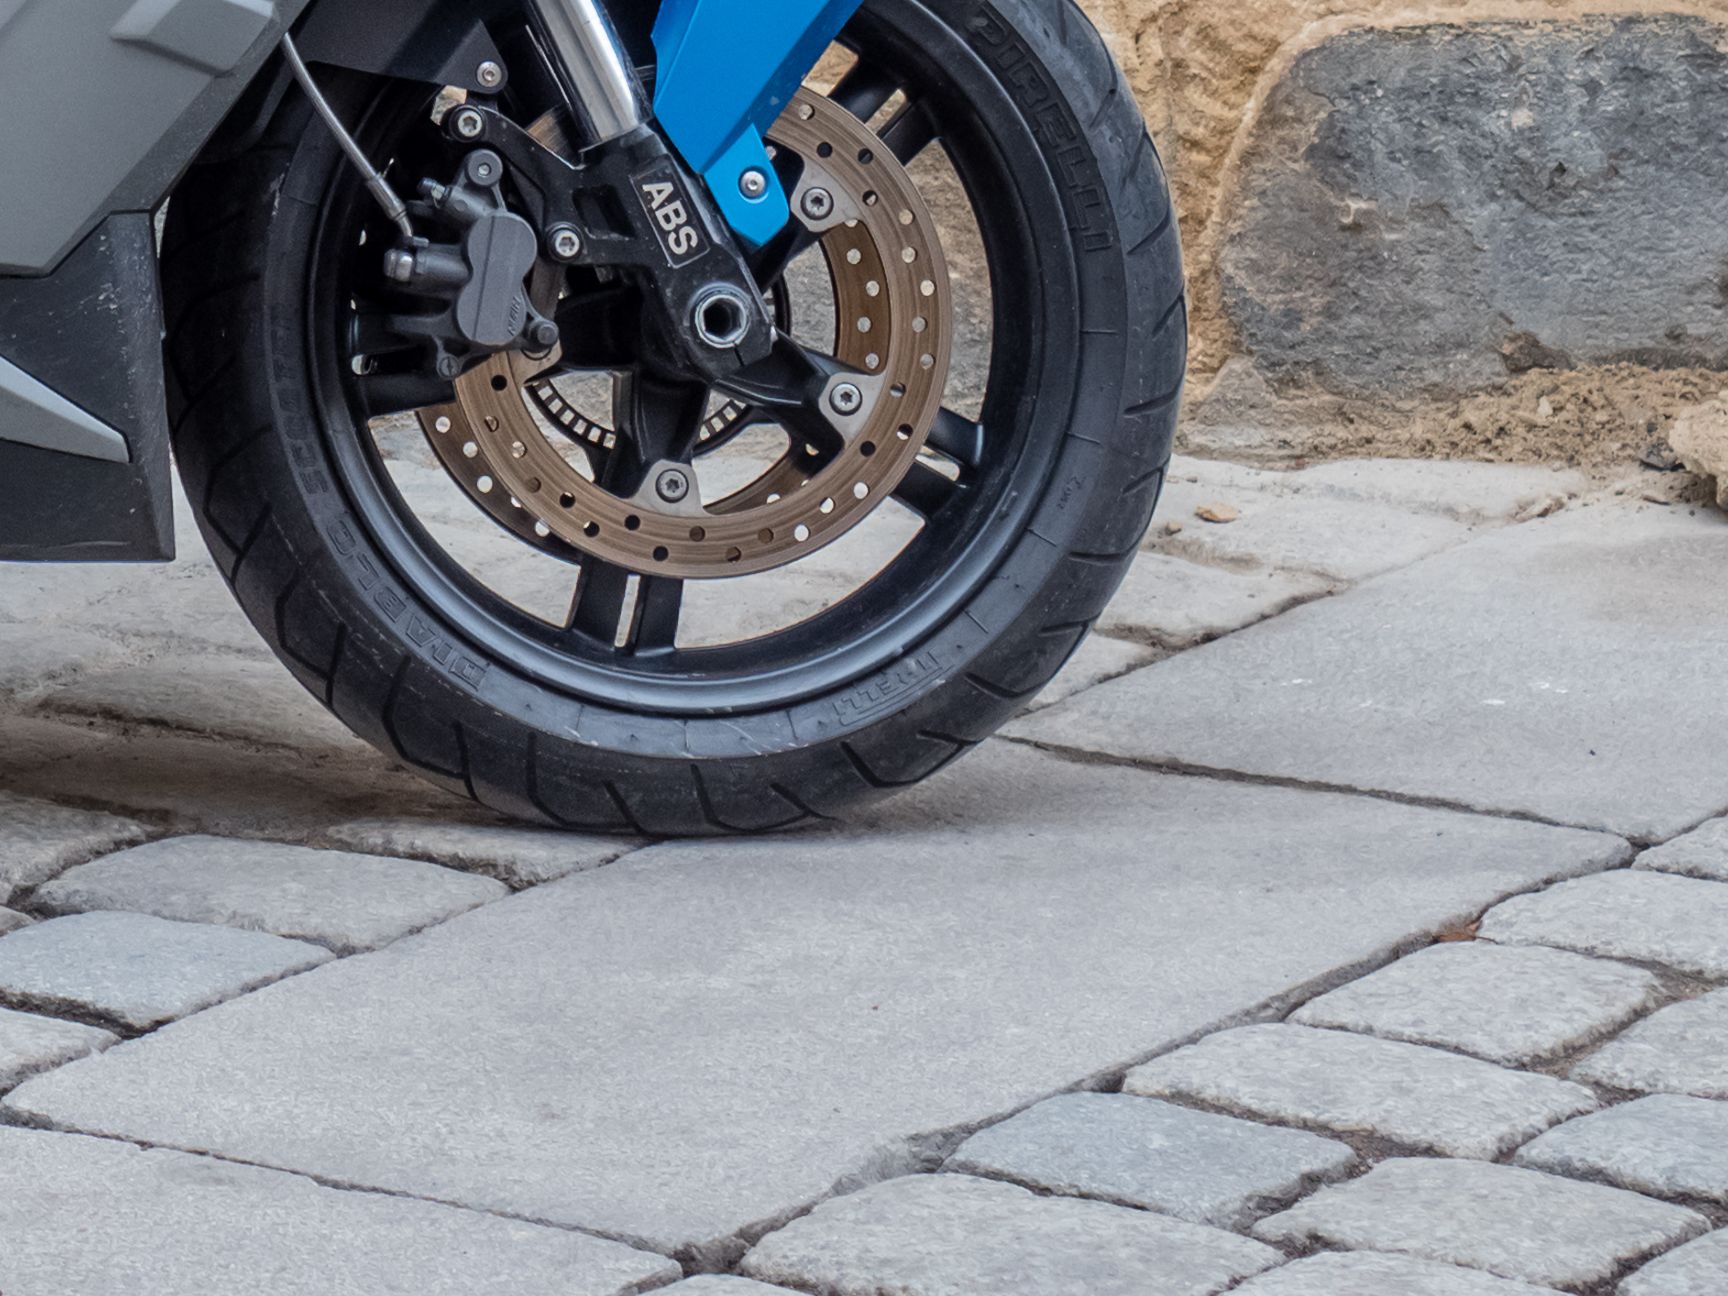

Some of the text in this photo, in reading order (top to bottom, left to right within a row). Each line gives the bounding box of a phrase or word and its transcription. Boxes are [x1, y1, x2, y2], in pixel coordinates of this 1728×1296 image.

[961, 4, 1115, 254] PIRELLI
[642, 180, 699, 256] ABS
[326, 518, 492, 692] DIABLO
